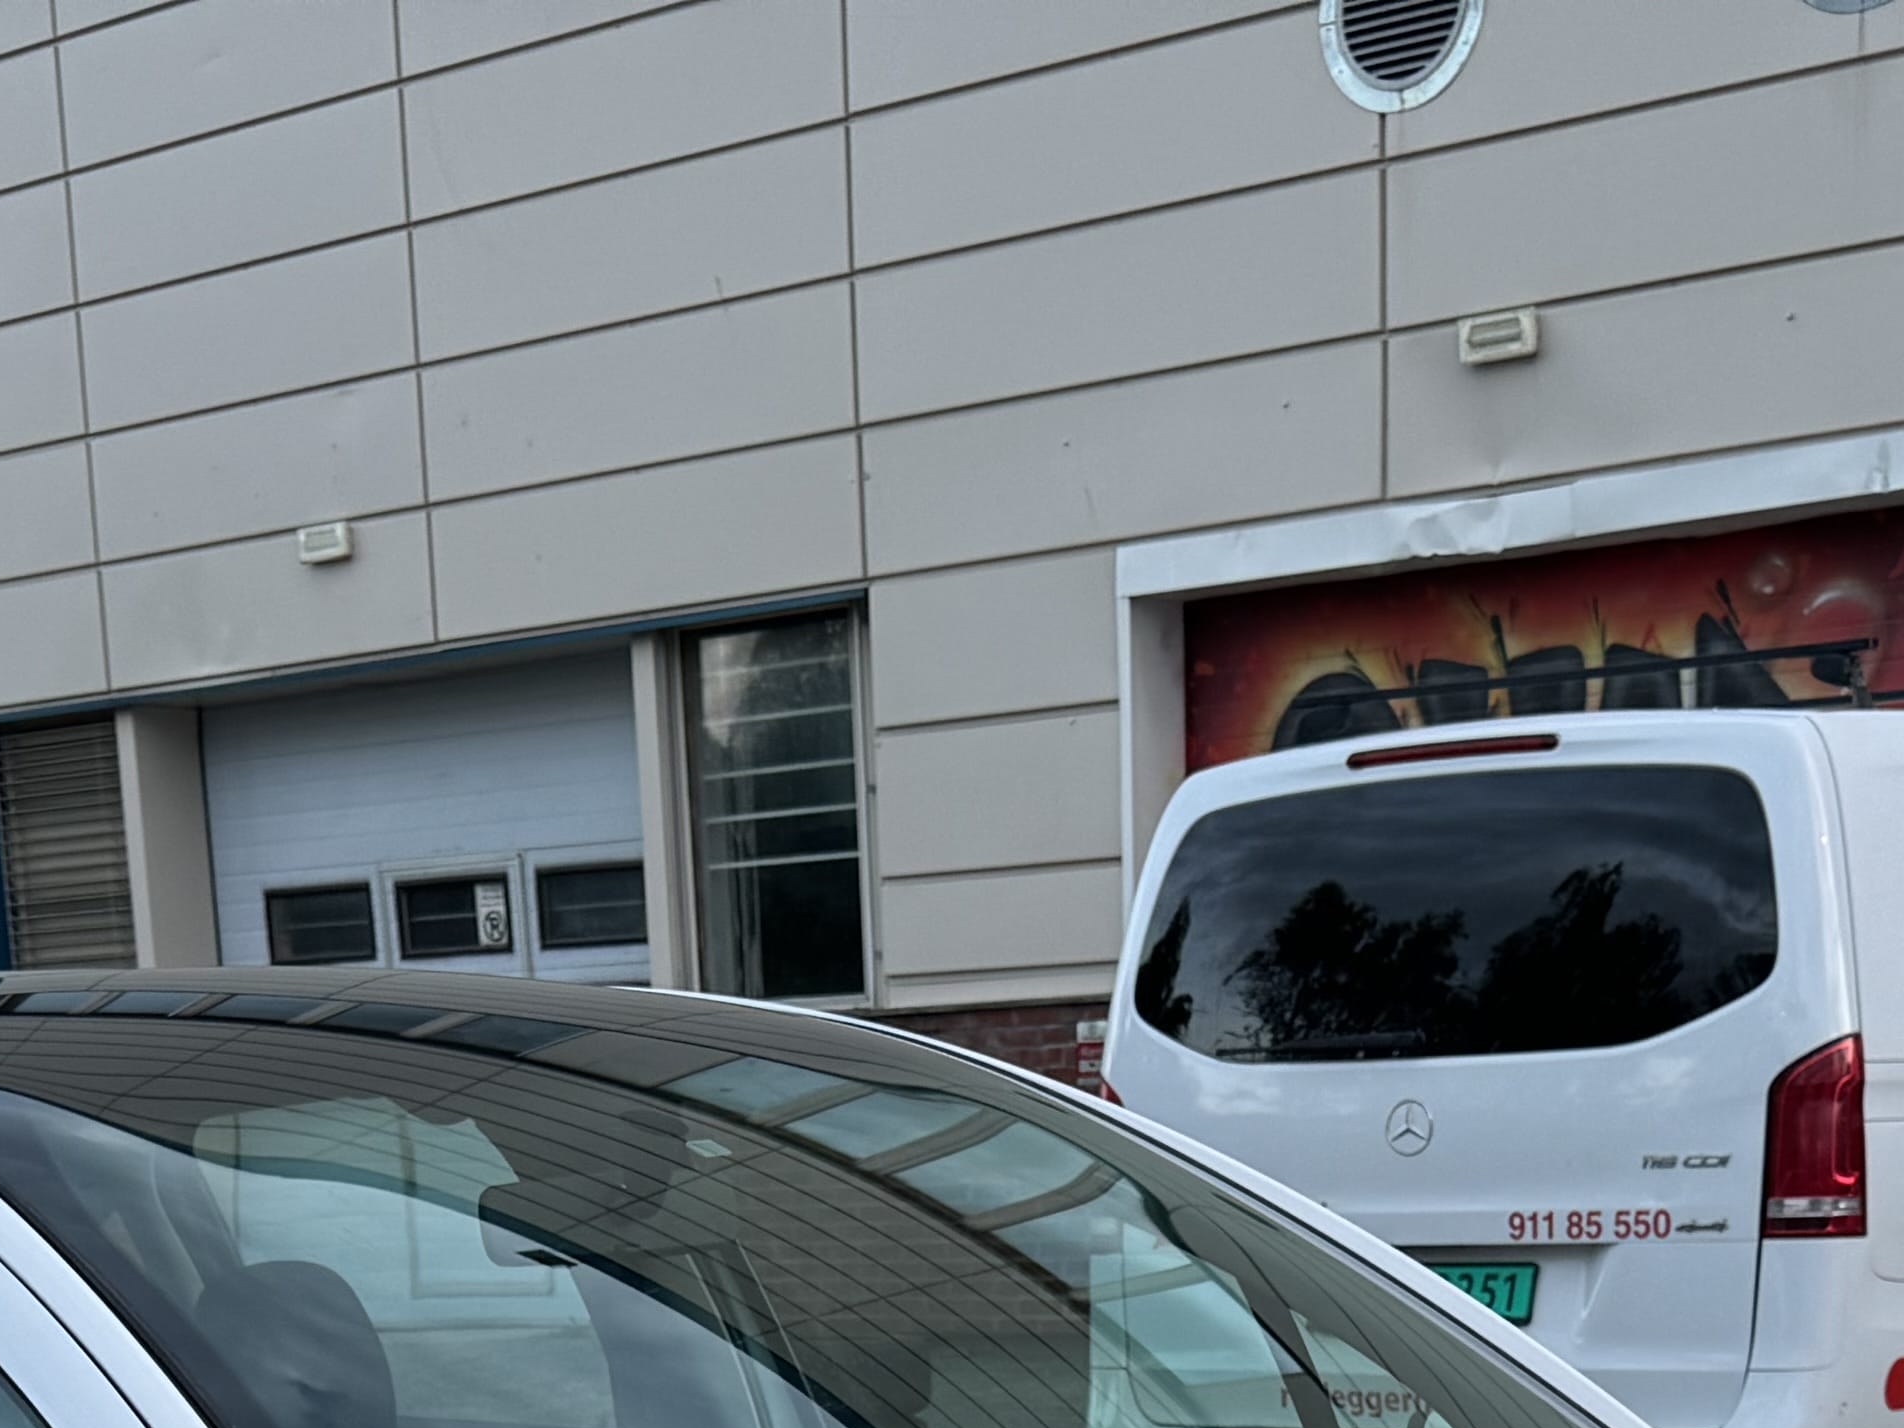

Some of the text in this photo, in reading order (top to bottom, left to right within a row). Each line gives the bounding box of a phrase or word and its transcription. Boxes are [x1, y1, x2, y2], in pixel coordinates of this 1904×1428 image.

[1683, 1152, 1731, 1169] CDI
[1508, 1208, 1671, 1241] 911 85 550
